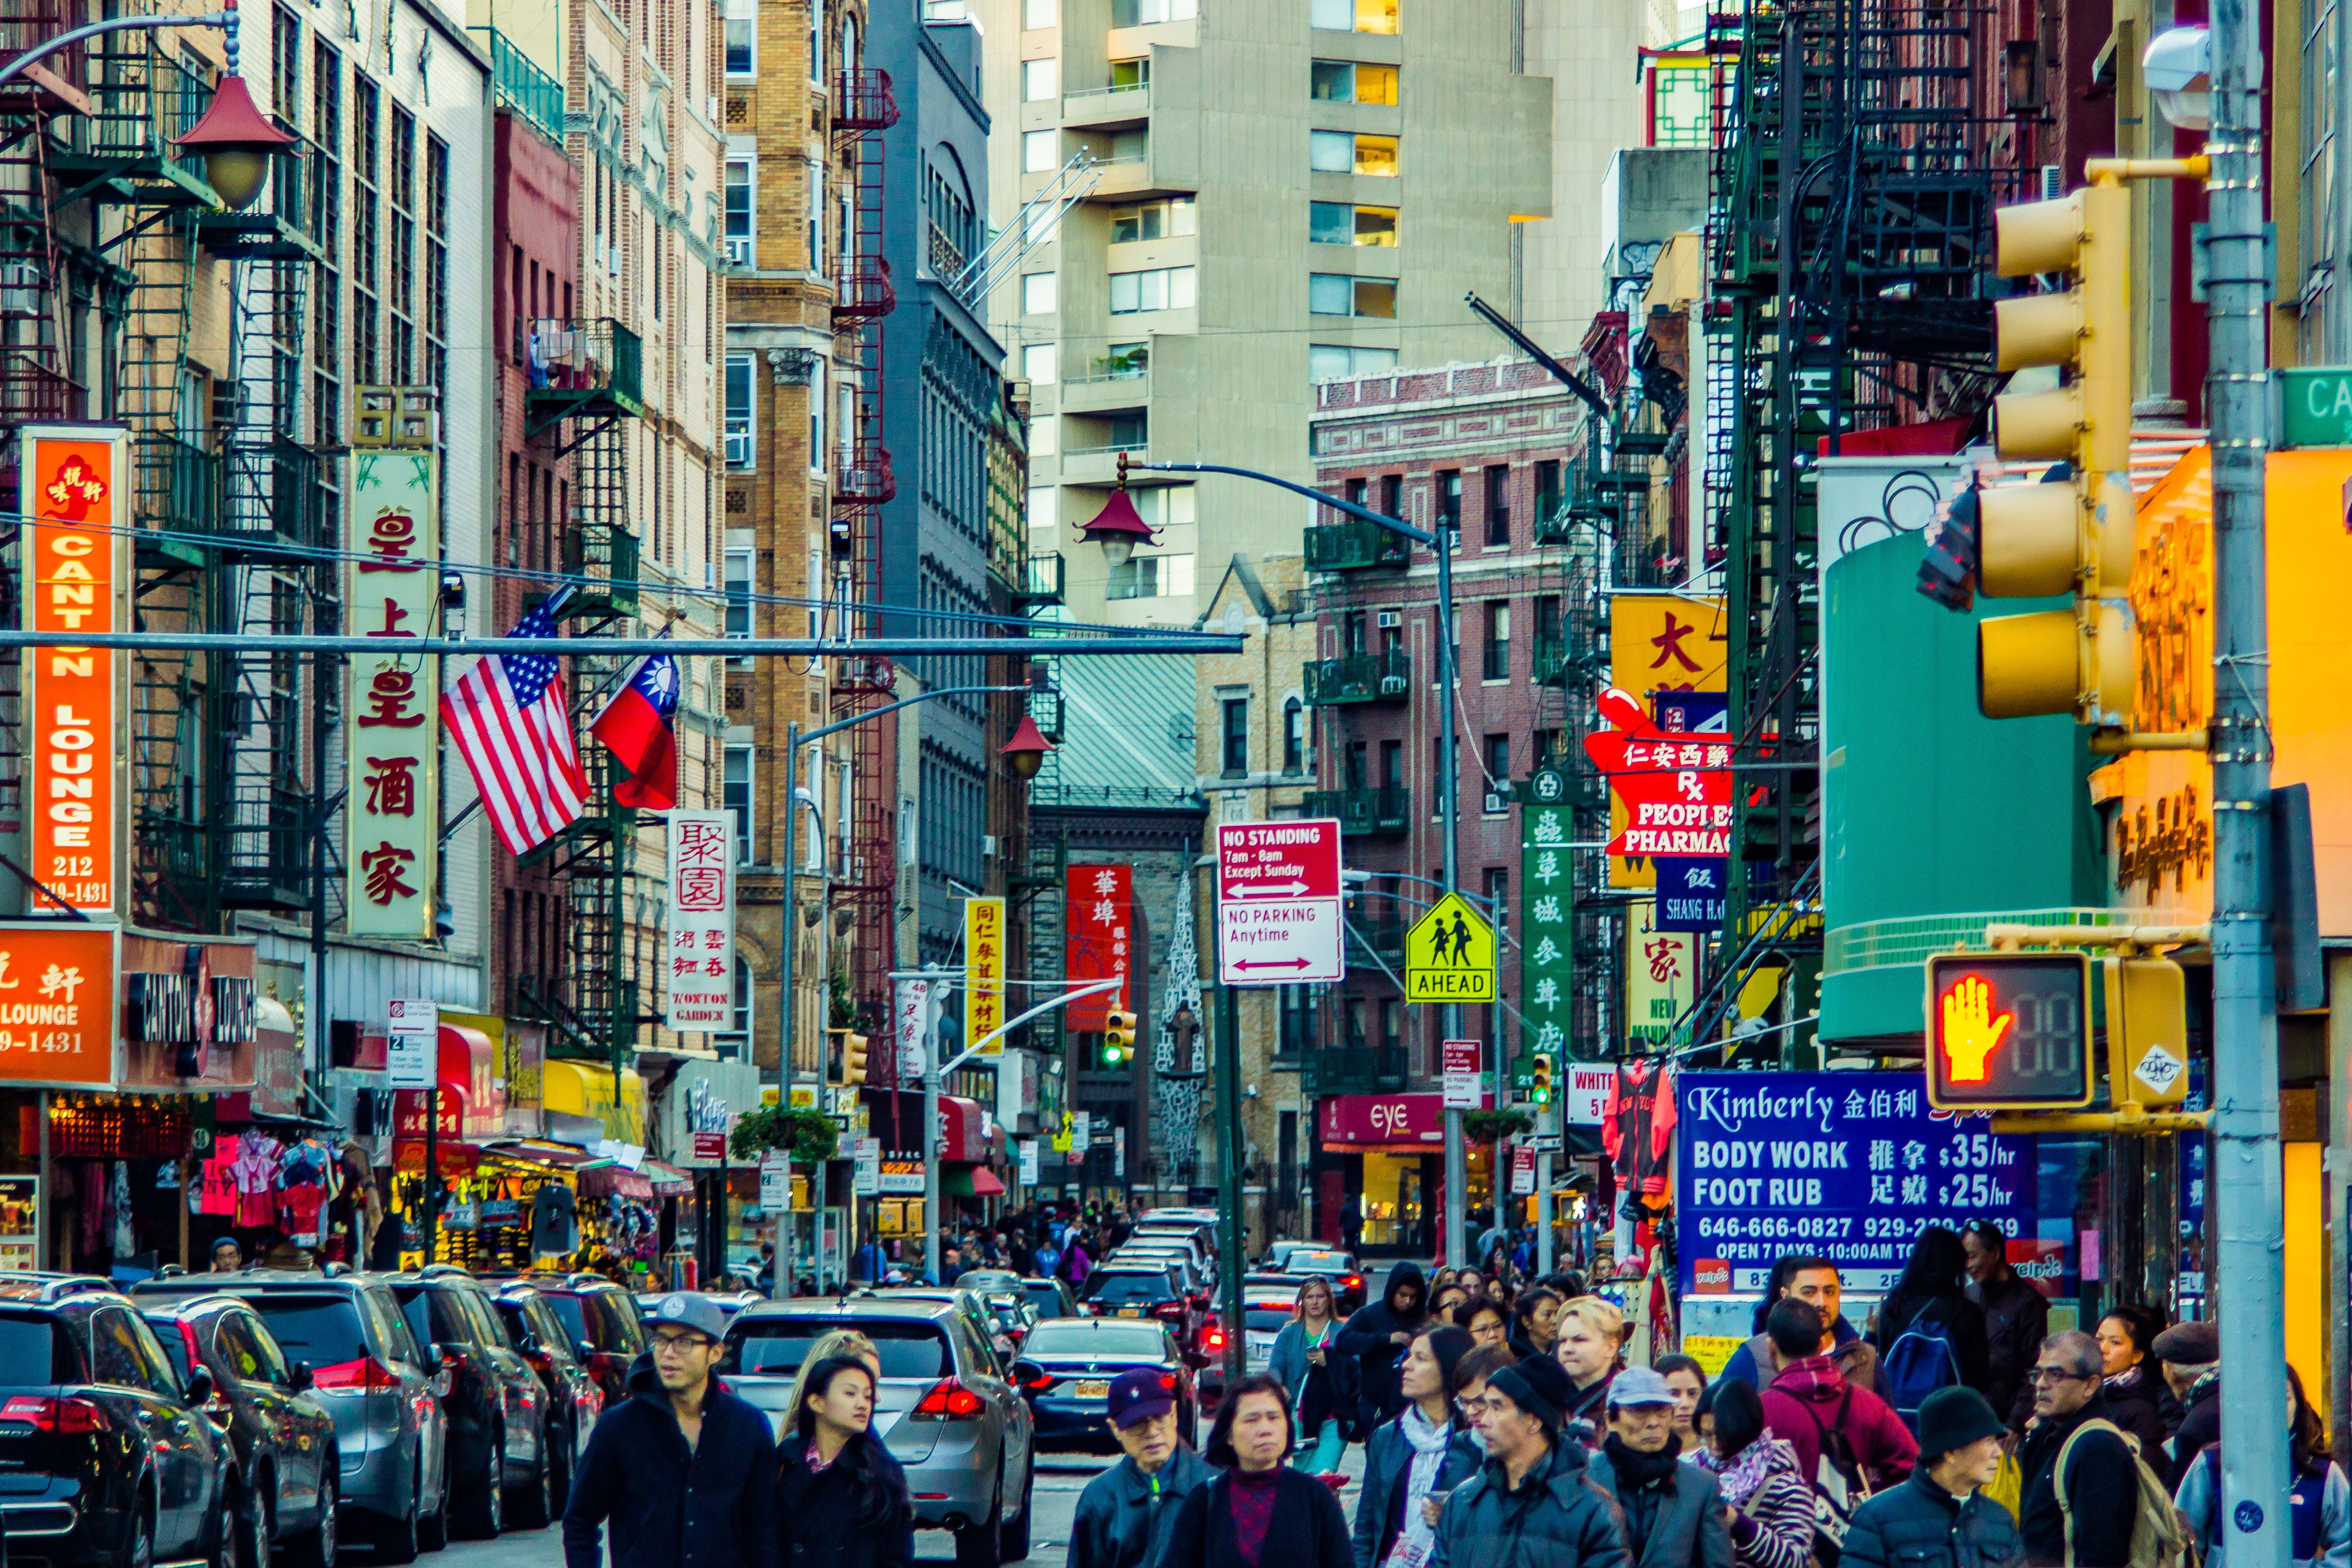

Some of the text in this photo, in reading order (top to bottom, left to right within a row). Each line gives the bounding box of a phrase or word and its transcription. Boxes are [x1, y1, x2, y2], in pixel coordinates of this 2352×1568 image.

[51, 536, 94, 677] CANTN
[50, 706, 94, 847] LOUNGE
[1224, 827, 1320, 847] NO STANDING
[53, 856, 93, 876] 212
[1225, 850, 1248, 864] 7am
[1258, 849, 1283, 863] 8am
[1225, 863, 1305, 880] Except Sunday
[1229, 907, 1316, 924] NO PARKING
[1667, 898, 1703, 920] SHANG
[1230, 928, 1289, 945] Anytime
[1418, 974, 1484, 993] AHEAD
[673, 993, 728, 1005] WONTON
[1650, 999, 1677, 1019] NEW
[1, 1003, 79, 1025] LOUNGE
[676, 1010, 723, 1021] GARDEN
[1688, 1086, 1834, 1133] Kimberly
[1842, 1088, 1917, 1119] 金伯利
[1694, 1141, 1849, 1169] BODY WORK
[1869, 1139, 1927, 1171] 推拿
[1939, 1133, 2016, 1168] $35/hr
[1694, 1178, 1822, 1206] FOOT RUB
[1939, 1173, 2013, 1208] $25/hr
[1699, 1217, 1852, 1238] 646-666-0827
[1716, 1243, 1759, 1259] OPEN
[1763, 1243, 1772, 1259] 7
[1775, 1243, 1815, 1259] DAYS
[1827, 1243, 1892, 1260] 10:00AM
